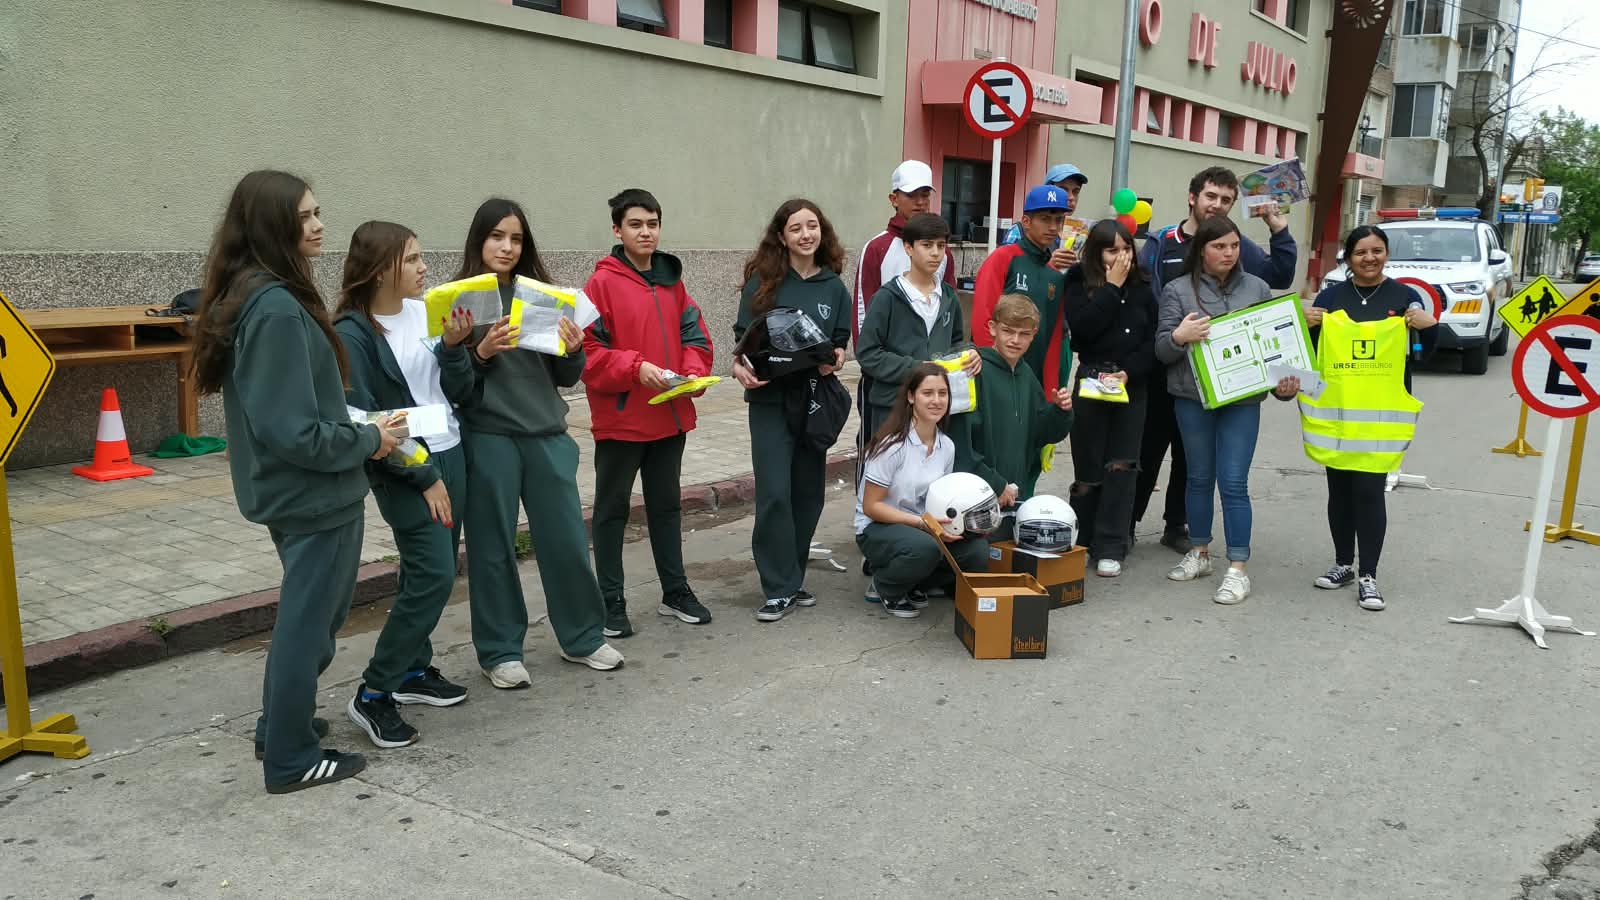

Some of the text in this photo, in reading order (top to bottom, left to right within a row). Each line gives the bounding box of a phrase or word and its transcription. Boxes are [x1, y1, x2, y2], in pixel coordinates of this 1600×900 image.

[1188, 12, 1222, 68] DE
[1241, 41, 1297, 97] JULIO
[983, 78, 1014, 123] E
[1544, 335, 1592, 397] E
